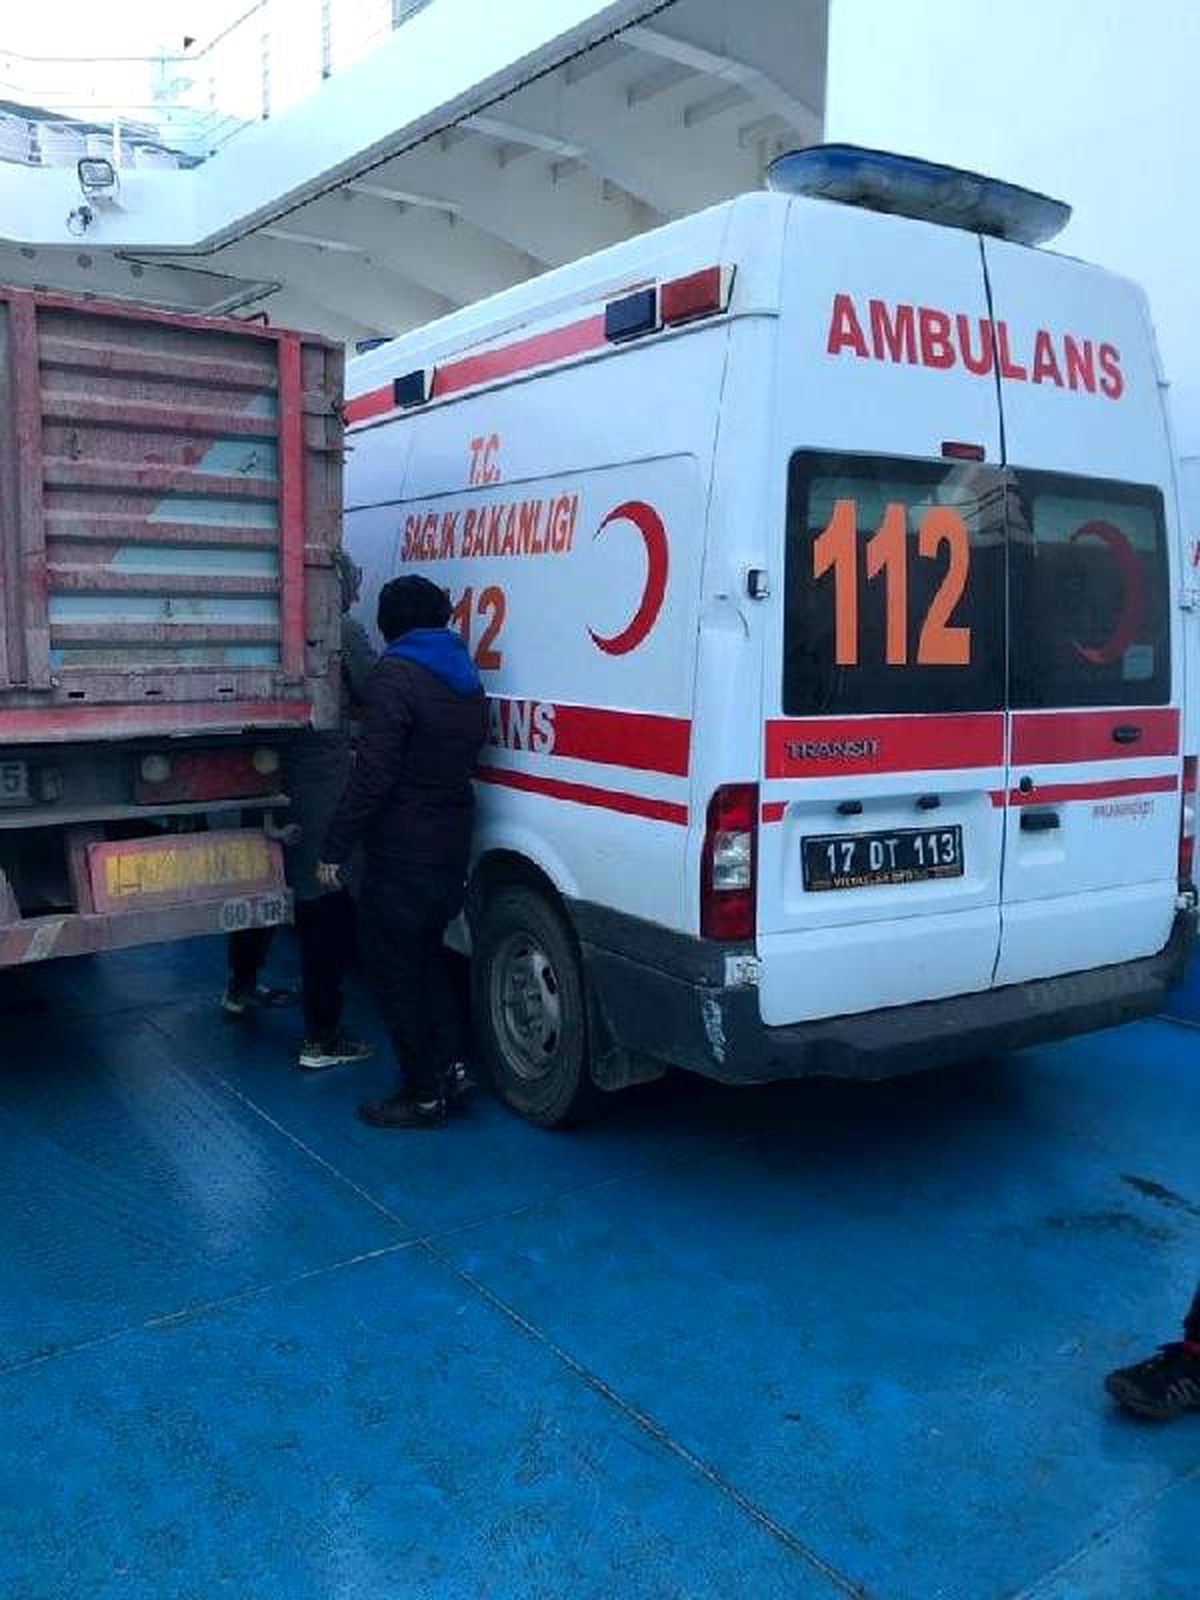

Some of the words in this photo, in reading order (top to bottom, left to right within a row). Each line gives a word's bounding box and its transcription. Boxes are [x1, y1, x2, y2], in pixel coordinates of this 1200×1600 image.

[826, 293, 1124, 401] AMBULANS
[469, 433, 500, 485] T.C.
[813, 499, 971, 666] 112
[448, 586, 506, 670] 12
[827, 841, 854, 873] 17
[869, 838, 898, 870] DT
[914, 833, 954, 864] 113
